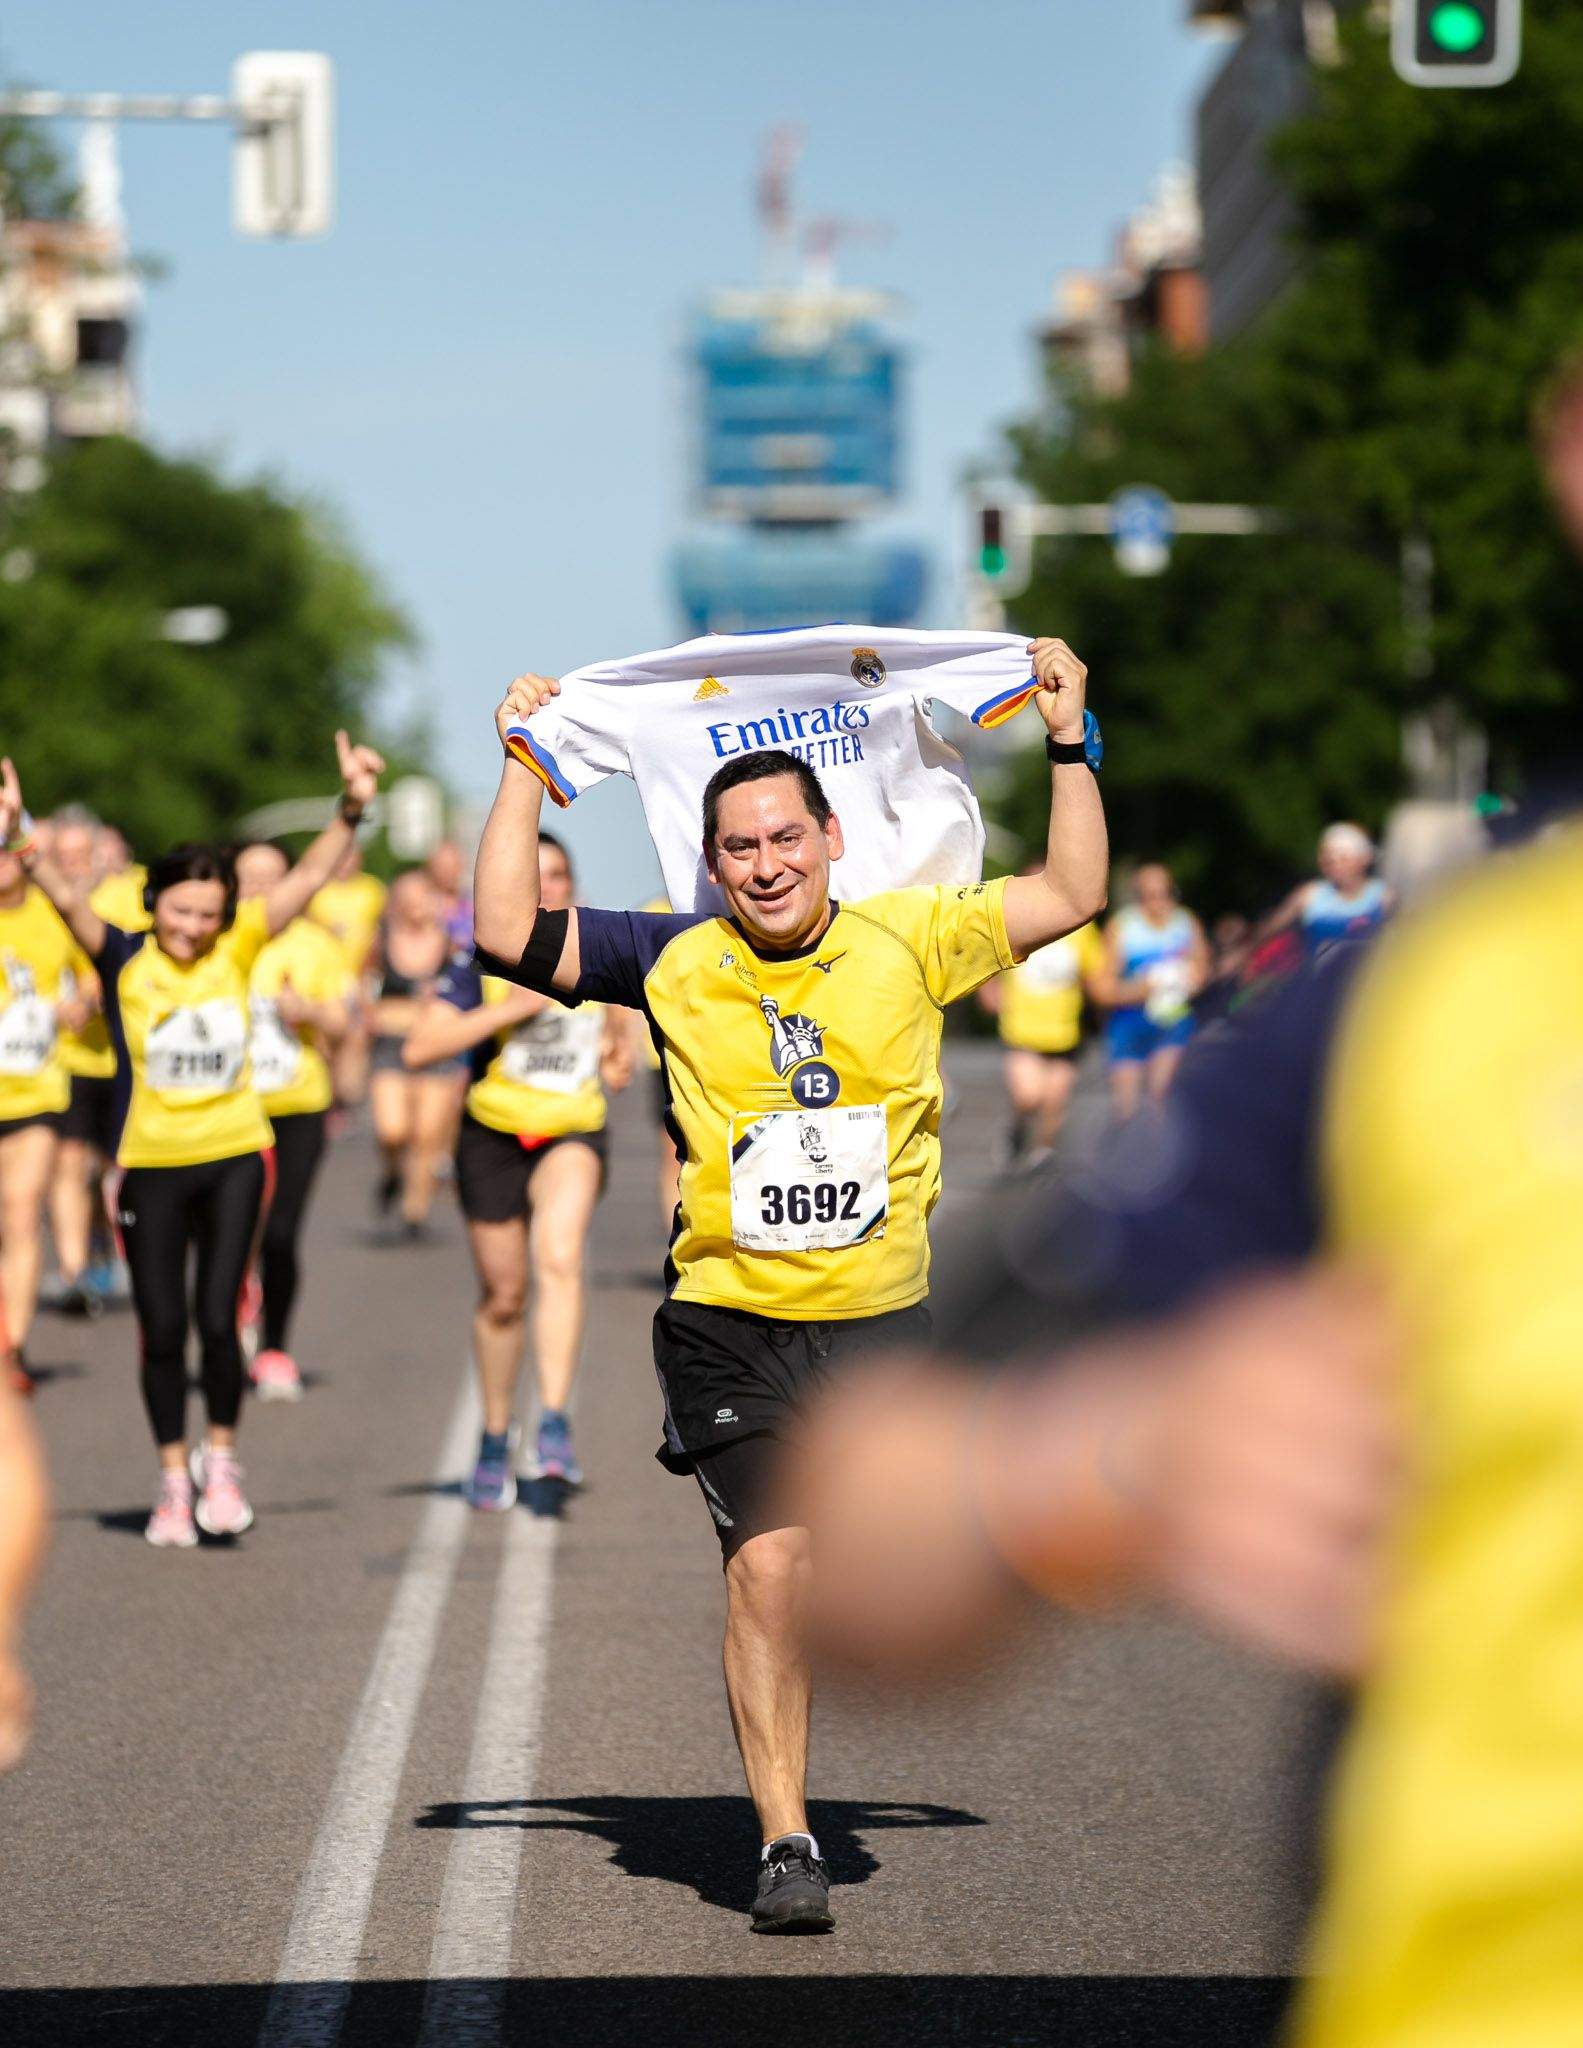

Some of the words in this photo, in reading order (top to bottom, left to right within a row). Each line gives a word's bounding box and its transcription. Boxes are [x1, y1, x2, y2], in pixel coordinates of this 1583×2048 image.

[705, 700, 871, 758] Emirates
[800, 1072, 830, 1099] 13
[760, 1181, 861, 1226] 3692
